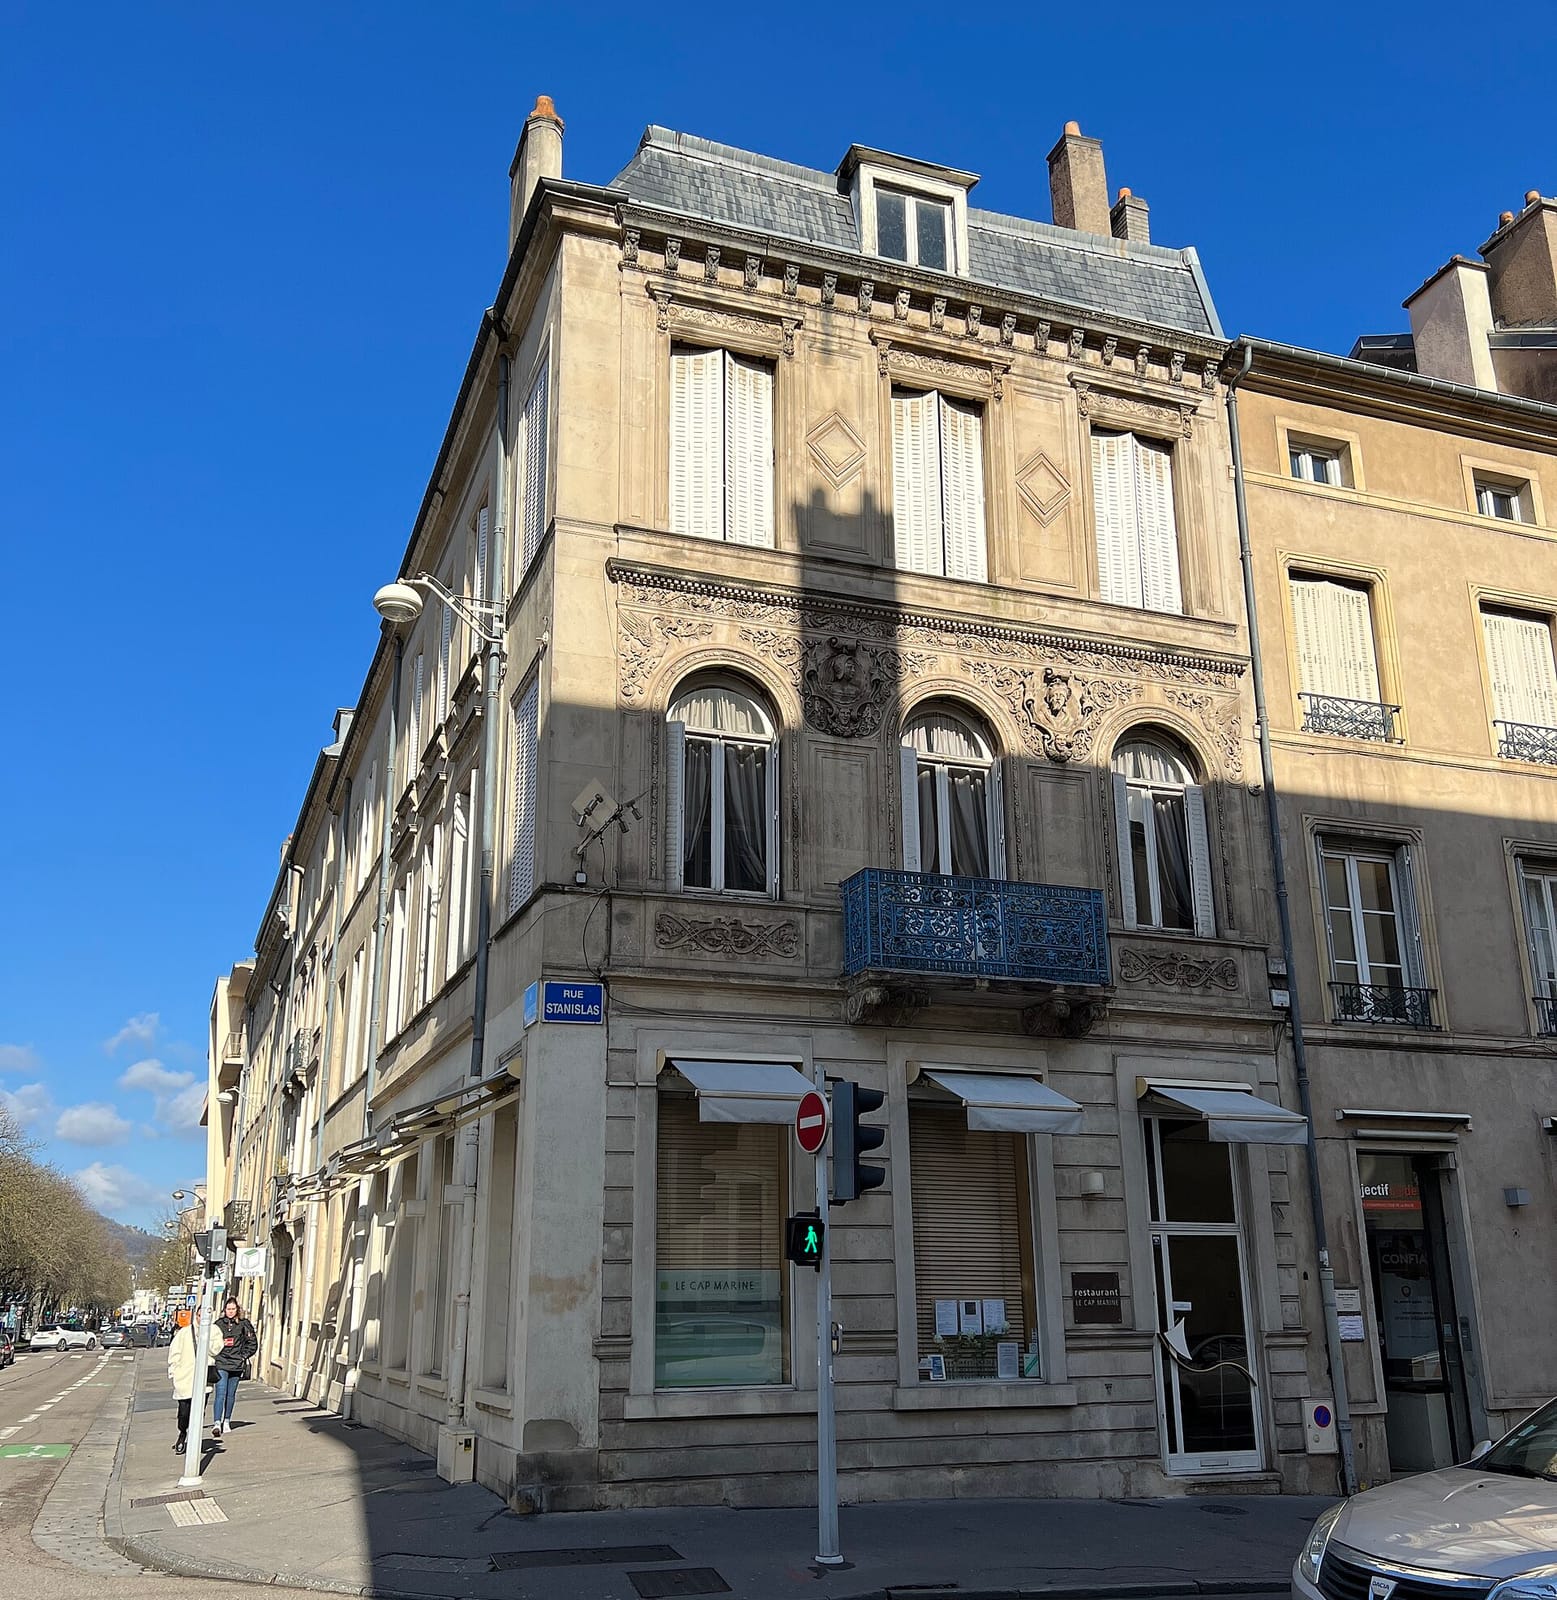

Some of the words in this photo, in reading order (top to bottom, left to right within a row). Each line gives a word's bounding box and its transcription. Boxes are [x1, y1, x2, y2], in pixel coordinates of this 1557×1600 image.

[563, 989, 584, 999] RUE
[546, 1003, 600, 1015] STANISLAS
[675, 1281, 686, 1291] LE
[689, 1281, 711, 1291] CAP
[713, 1281, 755, 1291] MARINE
[1074, 1288, 1119, 1297] restaurant
[1075, 1299, 1082, 1307] LE
[1372, 1580, 1390, 1590] DACIA
